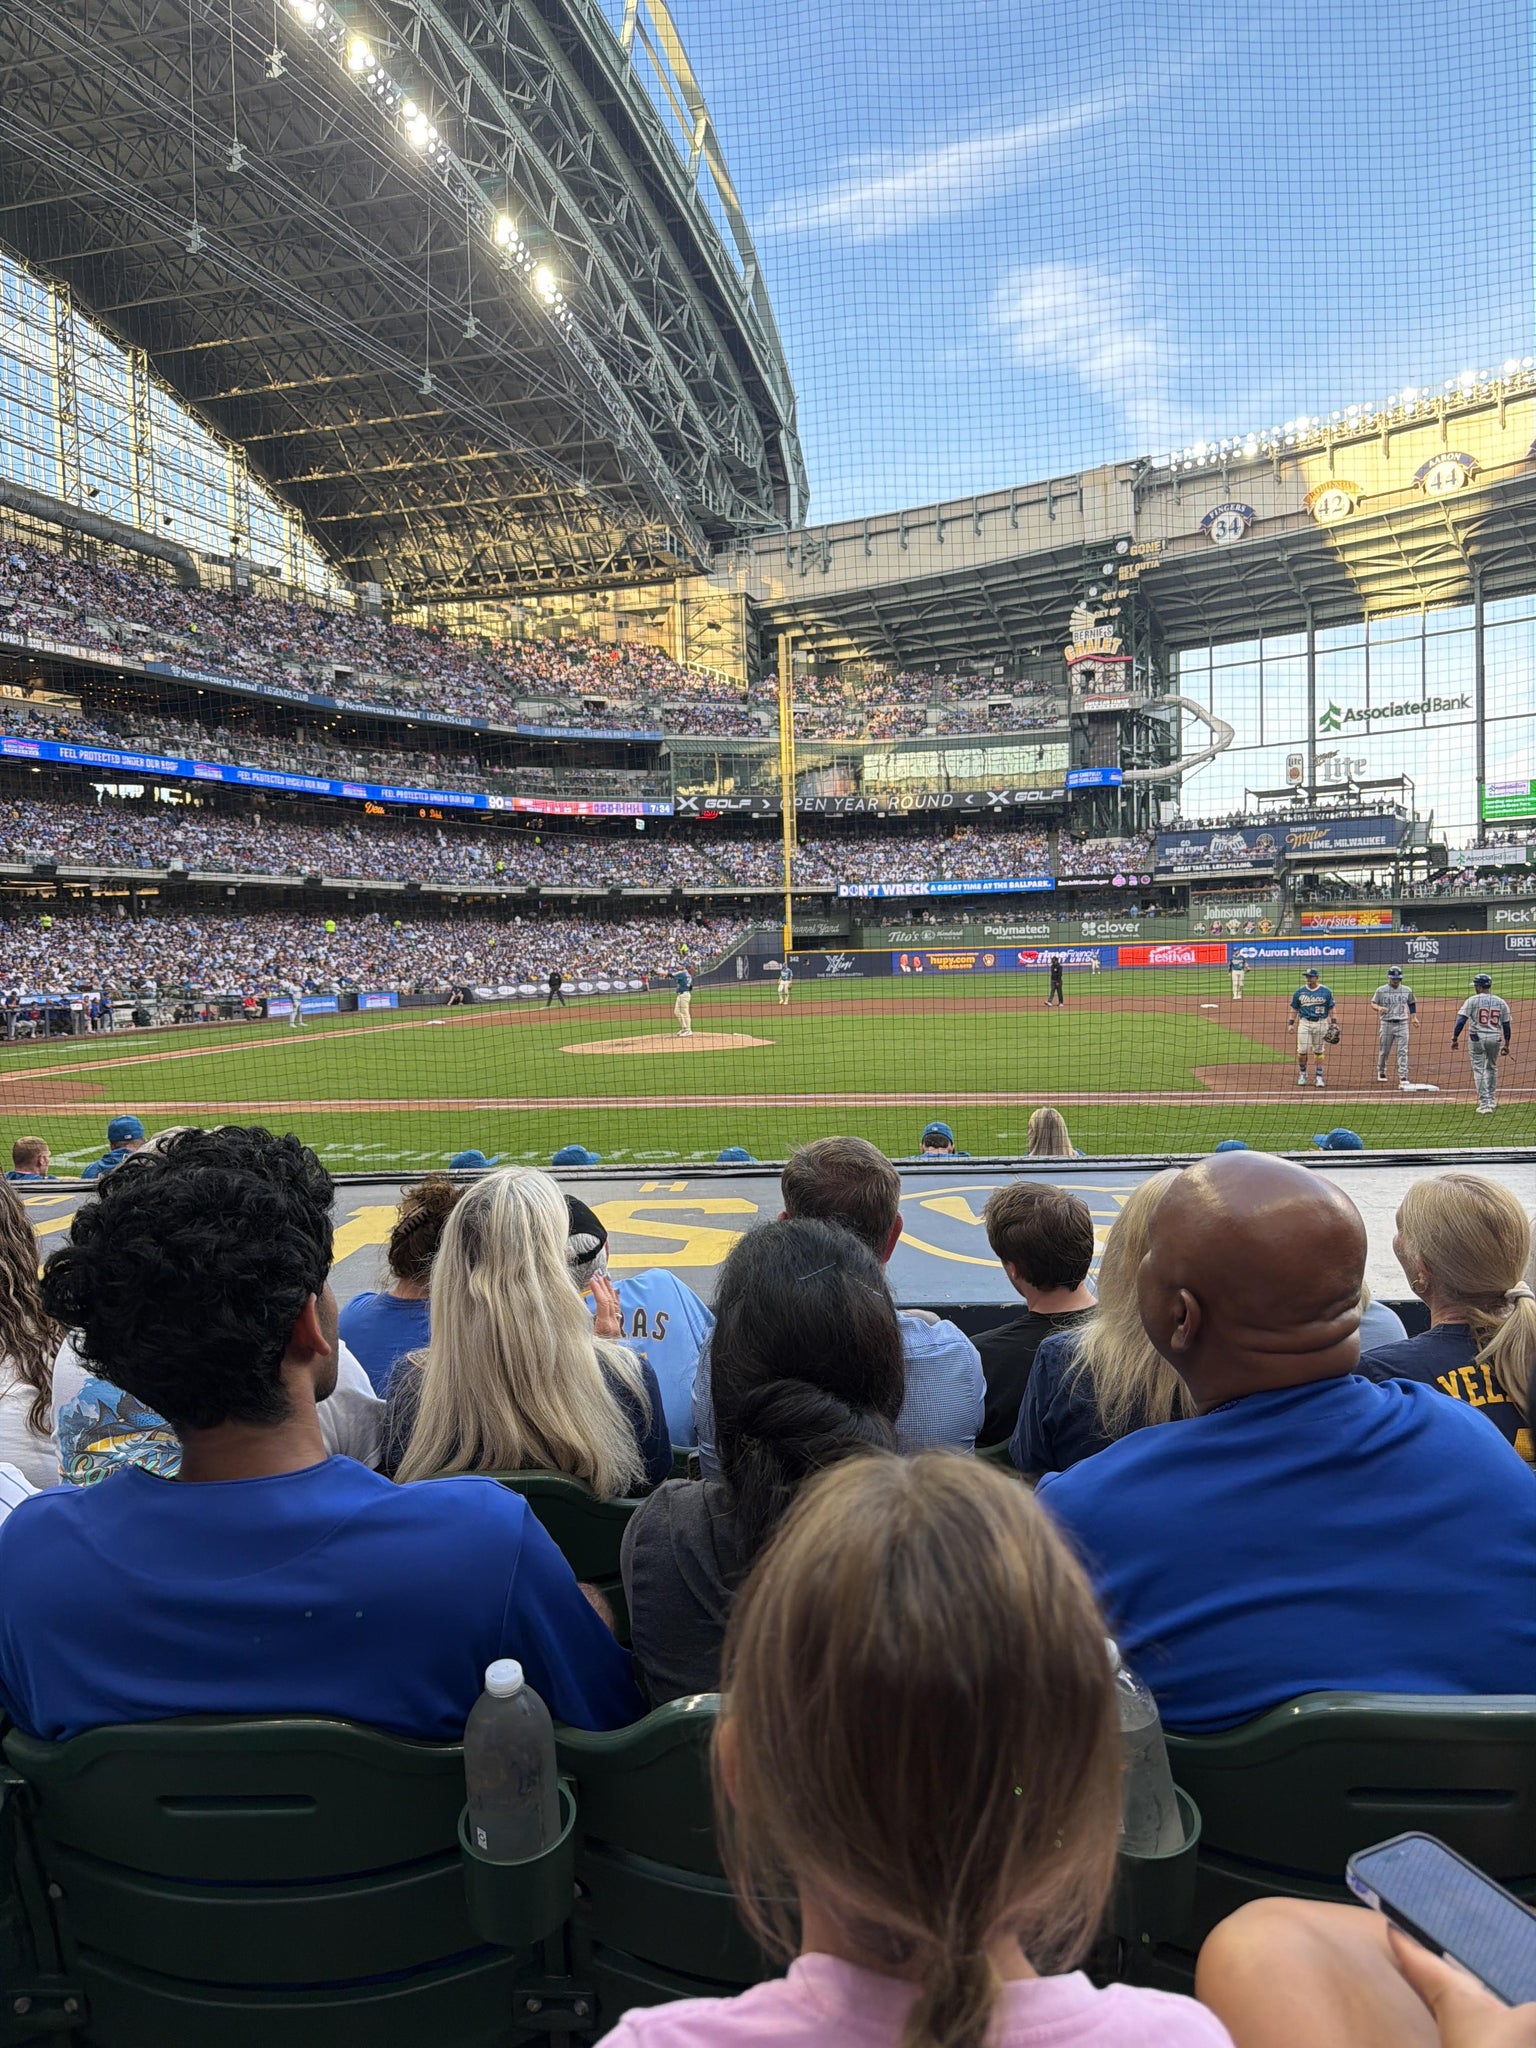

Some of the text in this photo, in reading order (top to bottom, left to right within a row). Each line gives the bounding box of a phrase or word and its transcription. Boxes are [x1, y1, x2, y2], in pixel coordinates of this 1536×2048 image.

[1428, 452, 1461, 469] AARON
[1431, 468, 1457, 490] 44
[1209, 503, 1246, 519] FINGERS
[1318, 495, 1342, 514] 42
[1216, 517, 1240, 538] 34
[1129, 539, 1166, 556] GONE!
[1118, 566, 1134, 574] GET
[1102, 589, 1130, 602] GET UP
[1109, 607, 1121, 617] UP
[1073, 625, 1113, 642] BERNIE'S
[1064, 636, 1122, 661] CHALET
[181, 668, 309, 702] Northwestern Mutual LEGENDS CLUB
[346, 701, 472, 726] Northwestern Mutual LEGENDS CLUB
[1343, 693, 1473, 723] Associated Bank
[59, 746, 78, 759] FEEL
[79, 750, 120, 764] PROTECTED
[121, 755, 145, 767] UNDER
[145, 759, 161, 769] OUR
[1322, 756, 1367, 783] Lite
[237, 770, 252, 781] FEEL
[252, 773, 285, 785] PROTECTED
[381, 788, 396, 798] FEEL
[396, 790, 428, 801] PROTECTED
[834, 796, 879, 811] YEAR
[888, 793, 953, 810] ROUND
[1014, 789, 1064, 802] GOLF
[488, 796, 504, 809] 90
[650, 805, 670, 813] 7:34
[705, 799, 751, 809] GOLF
[1180, 839, 1191, 847] GO
[1286, 828, 1331, 850] Miller
[1308, 835, 1387, 850] TIME, MILWAUKEE
[839, 883, 880, 897] DON'T
[881, 882, 930, 896] WRECK
[937, 883, 963, 892] GREAT
[963, 883, 982, 891] TIME
[982, 882, 993, 890] AT
[1008, 879, 1052, 889] BALLPARK.
[1204, 904, 1263, 920] Johnsonville
[1495, 909, 1530, 923] Pick
[1097, 921, 1140, 933] clover
[1310, 914, 1357, 929] Surfside
[888, 930, 920, 943] Tito's
[984, 924, 1050, 936] Polymatech
[1258, 946, 1346, 958] Aurora Health Care
[1405, 940, 1440, 955] TRUSS
[930, 955, 976, 966] hupy.com
[1149, 948, 1196, 963] festival
[1478, 1008, 1502, 1027] 65
